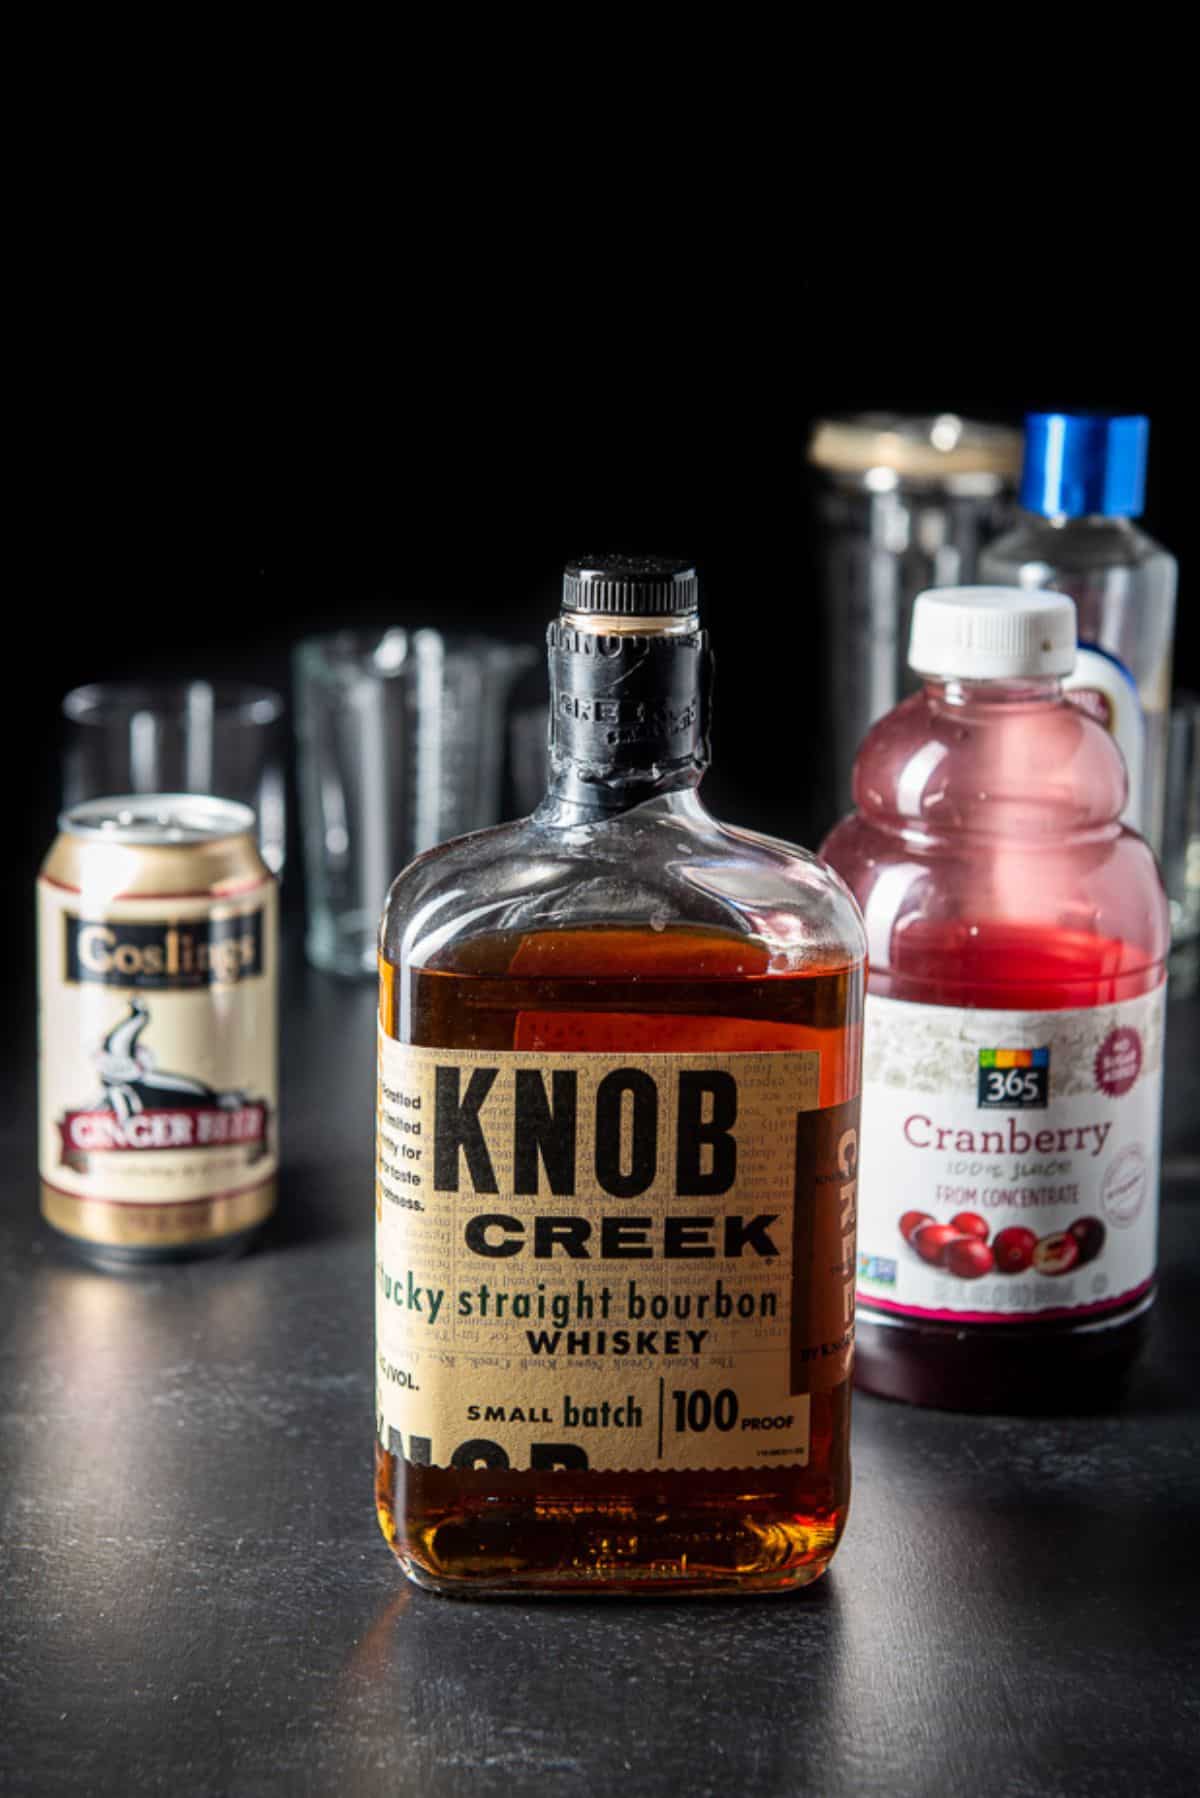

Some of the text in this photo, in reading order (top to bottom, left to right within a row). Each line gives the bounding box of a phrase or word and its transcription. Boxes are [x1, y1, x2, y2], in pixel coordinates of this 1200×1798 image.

[987, 1068, 1040, 1102] 365
[401, 1144, 423, 1161] for
[433, 1065, 738, 1199] KNOB
[903, 1114, 1113, 1156] Cranberry
[464, 1213, 782, 1260] CREEK
[457, 1279, 613, 1329] straight
[628, 1279, 778, 1320] bourbon
[525, 1330, 709, 1355] WHISKEY
[466, 1395, 643, 1428] SMALL batch
[672, 1388, 795, 1433] 100 PROOF
